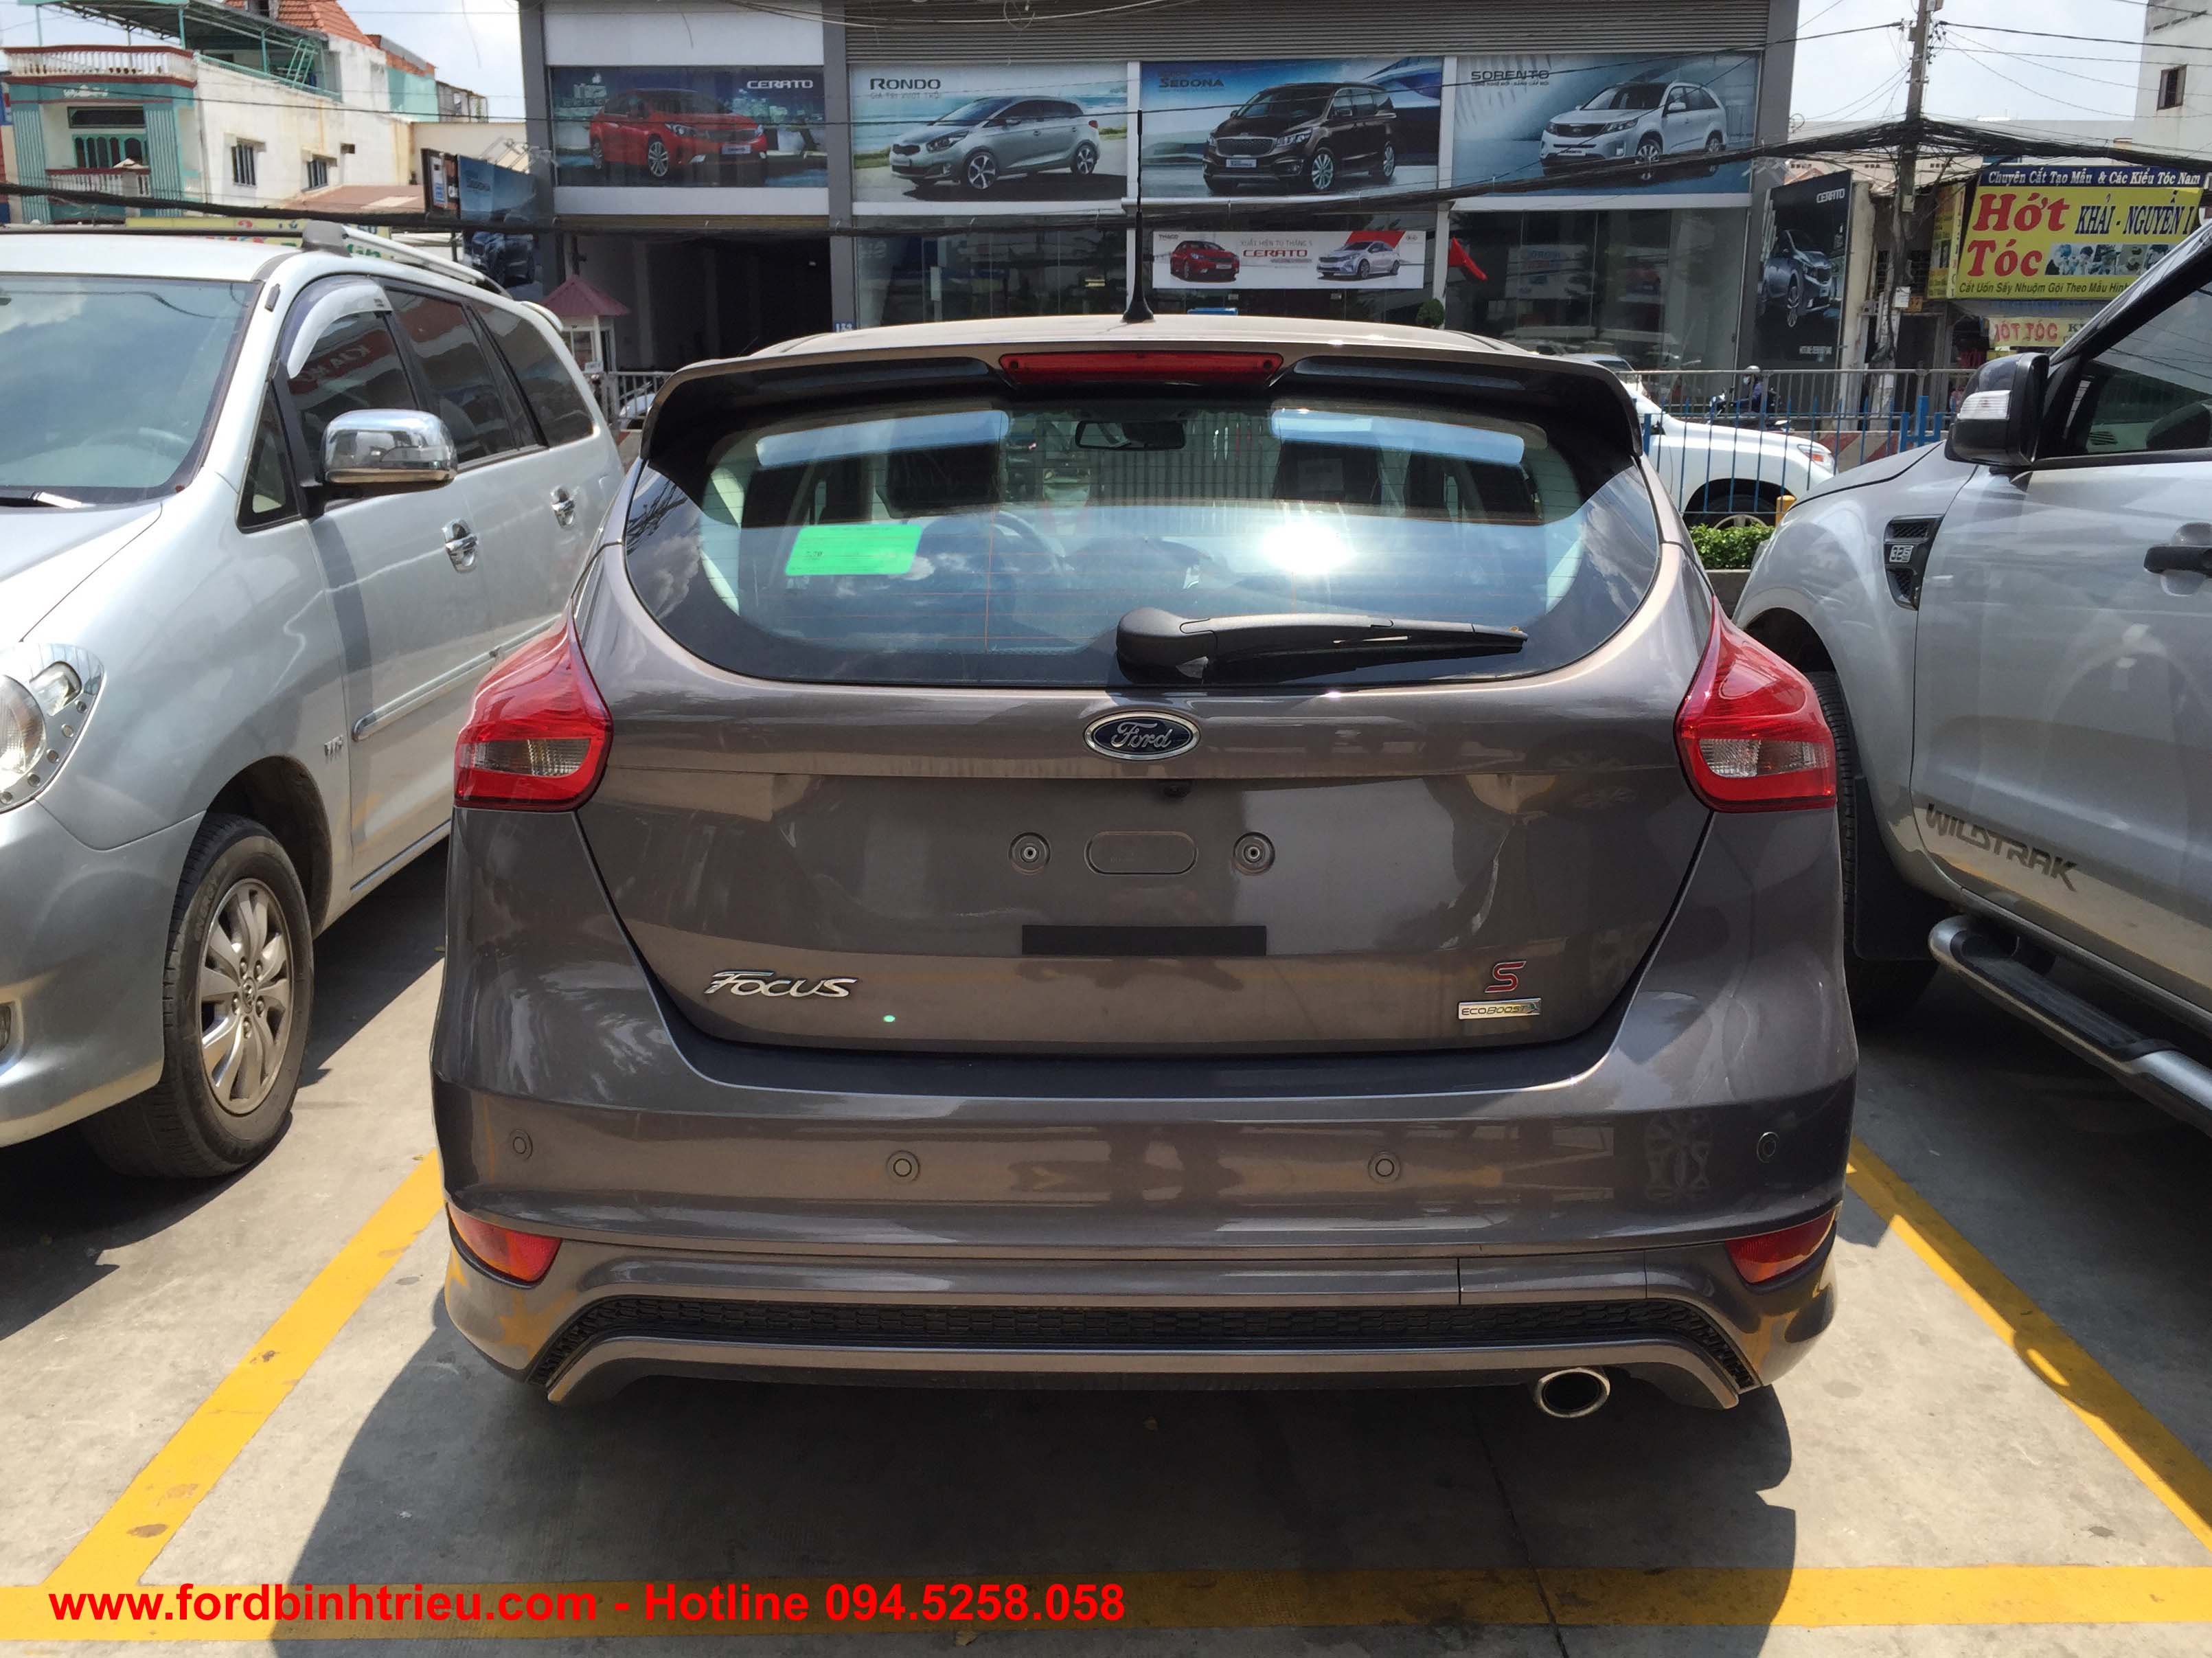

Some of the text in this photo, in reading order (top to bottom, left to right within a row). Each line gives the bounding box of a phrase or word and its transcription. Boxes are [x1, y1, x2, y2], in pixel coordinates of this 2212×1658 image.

[1159, 76, 1225, 88] SEDONA
[1471, 69, 1549, 80] SORENTO
[746, 80, 814, 89] CERATO
[869, 78, 942, 90] RONDO
[1988, 170, 2026, 186] Chuyên
[2029, 167, 2047, 184] Cắt
[2049, 171, 2068, 186] Tạo
[2098, 171, 2107, 184] &
[2109, 171, 2128, 184] Các
[2130, 168, 2155, 185] Kiểu
[2157, 171, 2176, 185] Tóc
[2177, 172, 2201, 185] Nam
[1816, 188, 1846, 203] CERATO
[1972, 192, 2071, 231] Hớt
[2074, 193, 2116, 235] KHẢI
[1243, 249, 1308, 258] CERATO
[1967, 238, 2043, 277] Tóc
[2066, 282, 2087, 293] Theo
[1110, 722, 1172, 748] Ford
[1926, 803, 2077, 892] WILDTRAK
[1485, 961, 1527, 993] S
[1461, 1005, 1527, 1016] ECOBOOST
